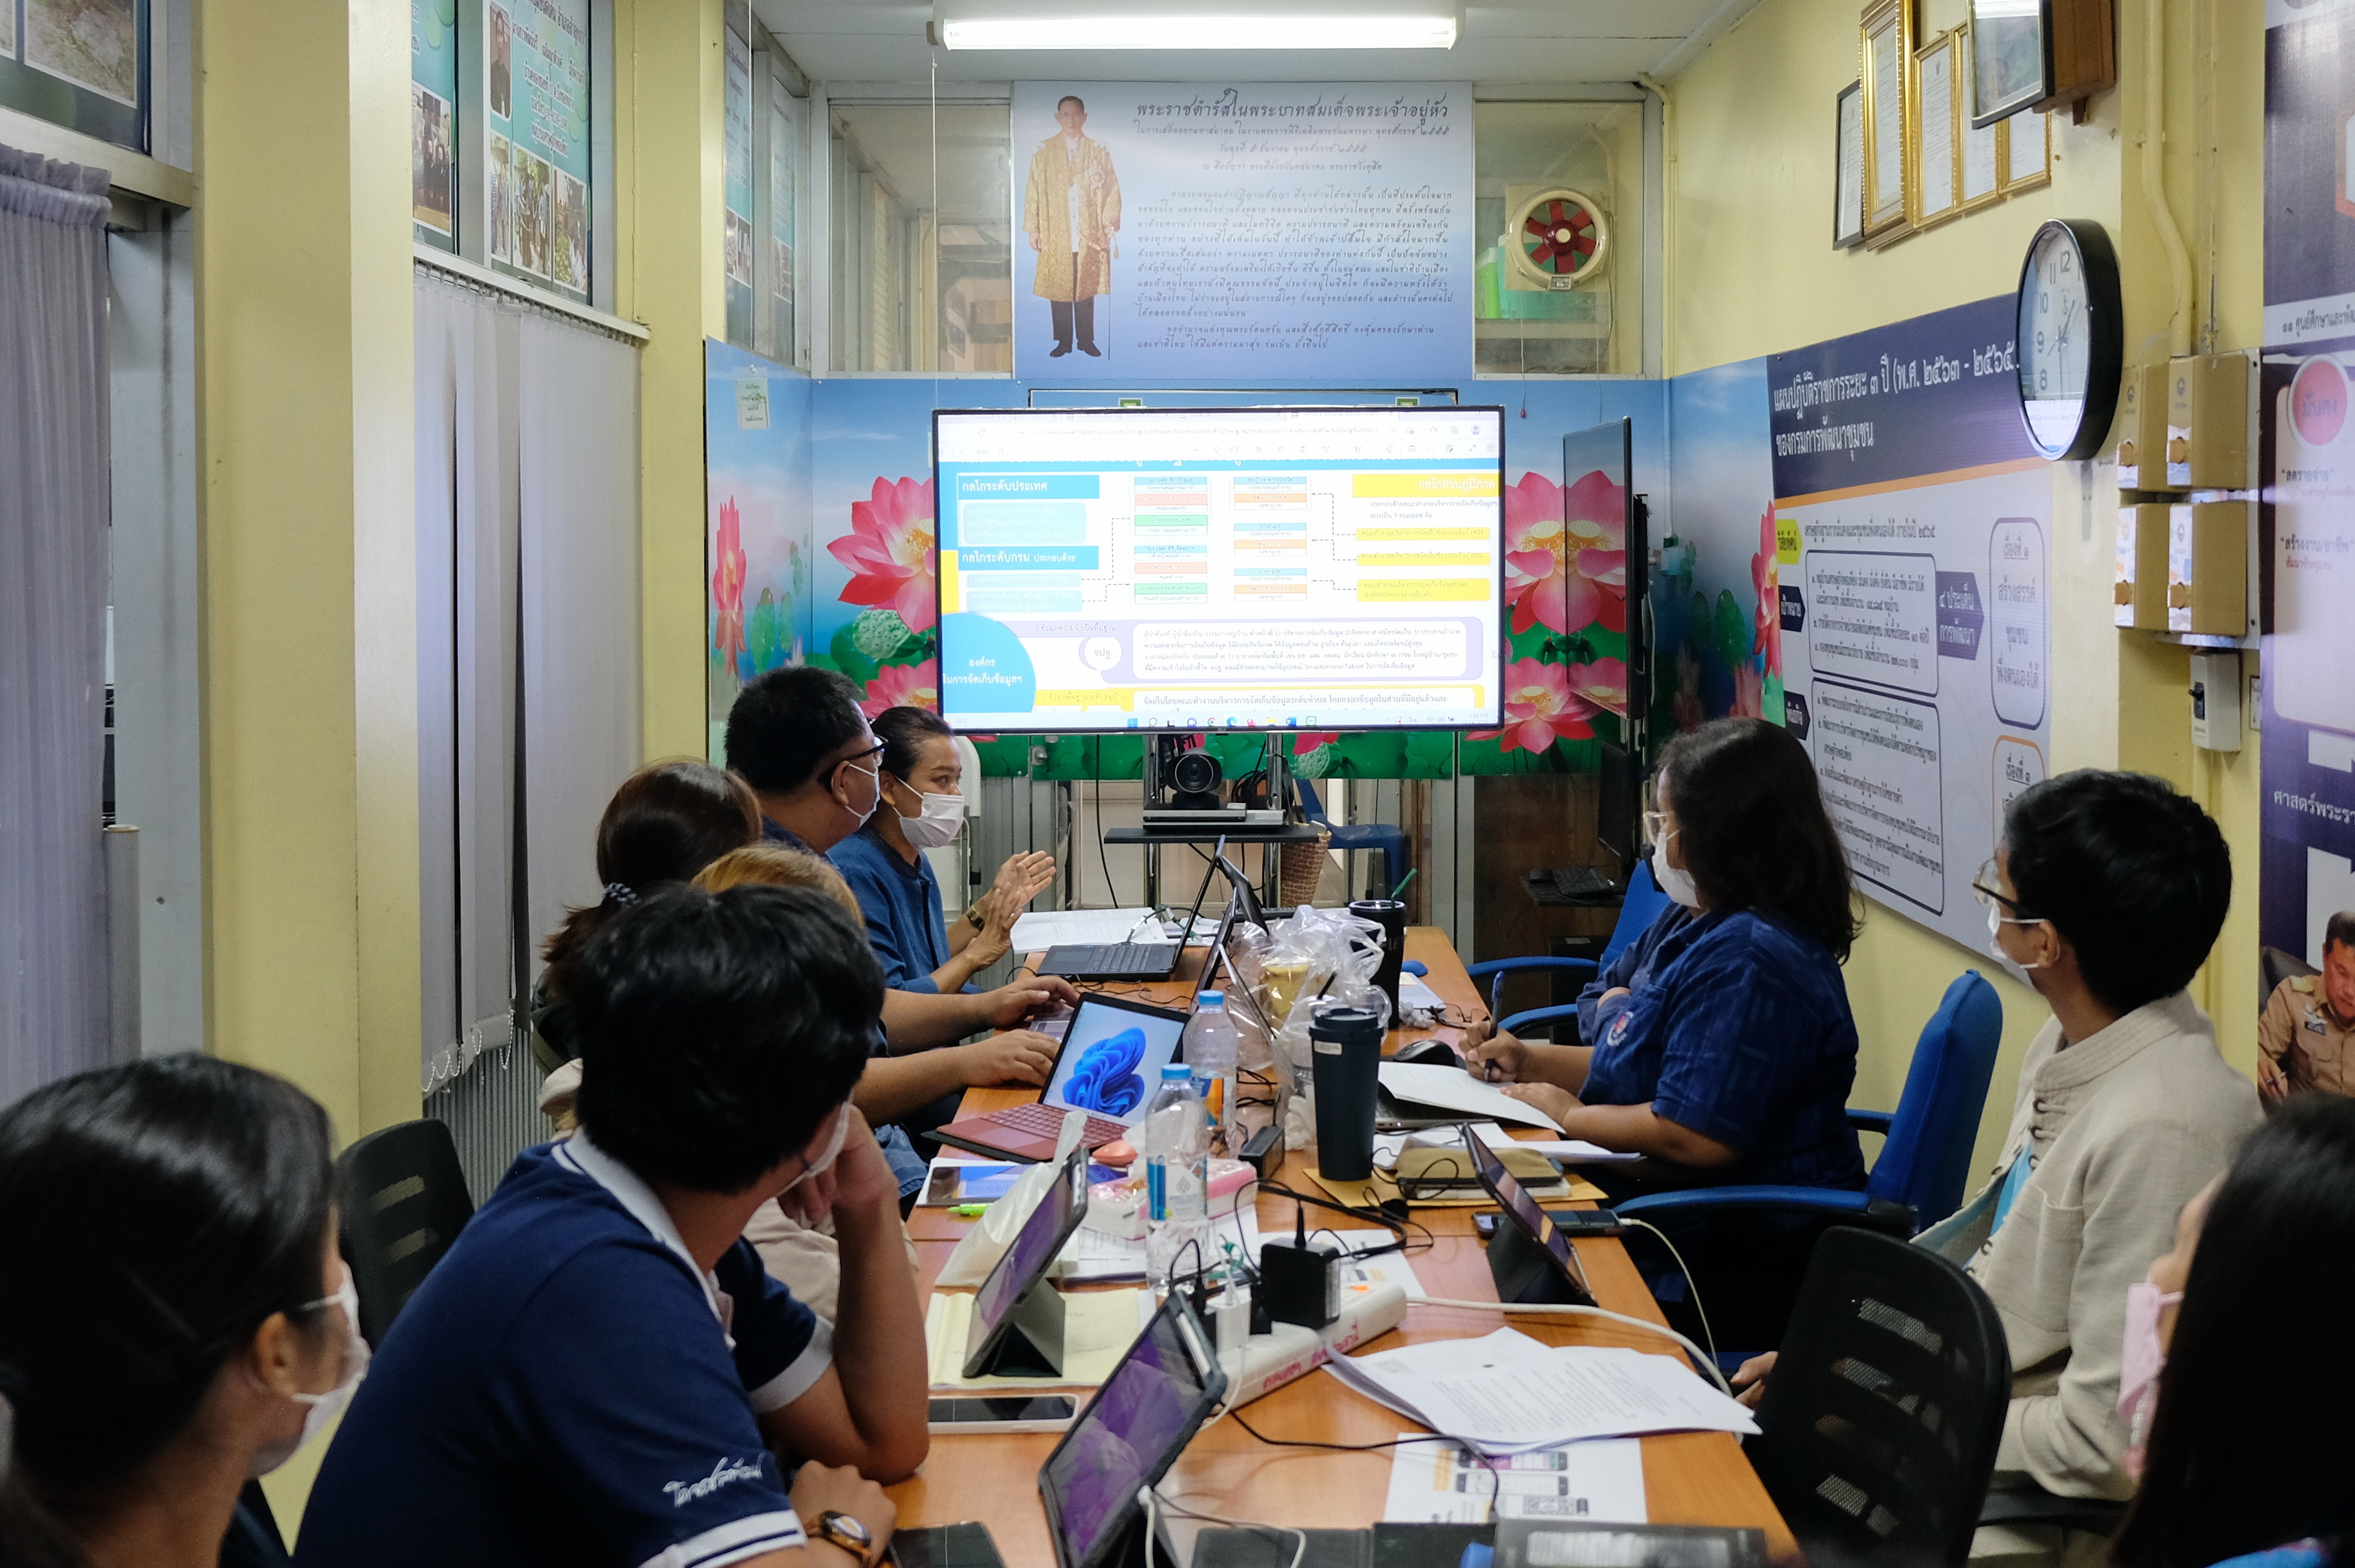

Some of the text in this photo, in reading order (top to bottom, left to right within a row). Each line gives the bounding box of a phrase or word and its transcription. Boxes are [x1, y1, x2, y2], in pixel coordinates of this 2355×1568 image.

[1137, 88, 1448, 126] พระราชดำรัสในพระบาทสมเด็จพระเจ้าอยู่หัว
[2059, 249, 2071, 273] 12
[2049, 263, 2056, 285] 11
[2039, 291, 2049, 314] 10
[2036, 333, 2044, 353] 9
[1774, 370, 1868, 420] แผนปฏิบัติราชการระยะ
[1870, 376, 1879, 395] ๓
[1880, 353, 1890, 393] ปี
[1892, 357, 1920, 394] (พ.ศ.
[1923, 357, 1960, 386] ๒๕๖๓
[1973, 340, 2019, 378] ๒๕๖๕
[2039, 370, 2048, 391] 8
[1776, 416, 1874, 461] ของกรมการพัฒนาชุมชน
[963, 479, 1048, 492] กลไกระดับประเทศ
[1418, 477, 1495, 493] กลไกส่วนภูมิภาค
[963, 550, 1076, 563] กลไกระดับกรม ประกอบด้วย
[968, 656, 996, 667] องค์กร
[1094, 649, 1113, 659] จปฐ.
